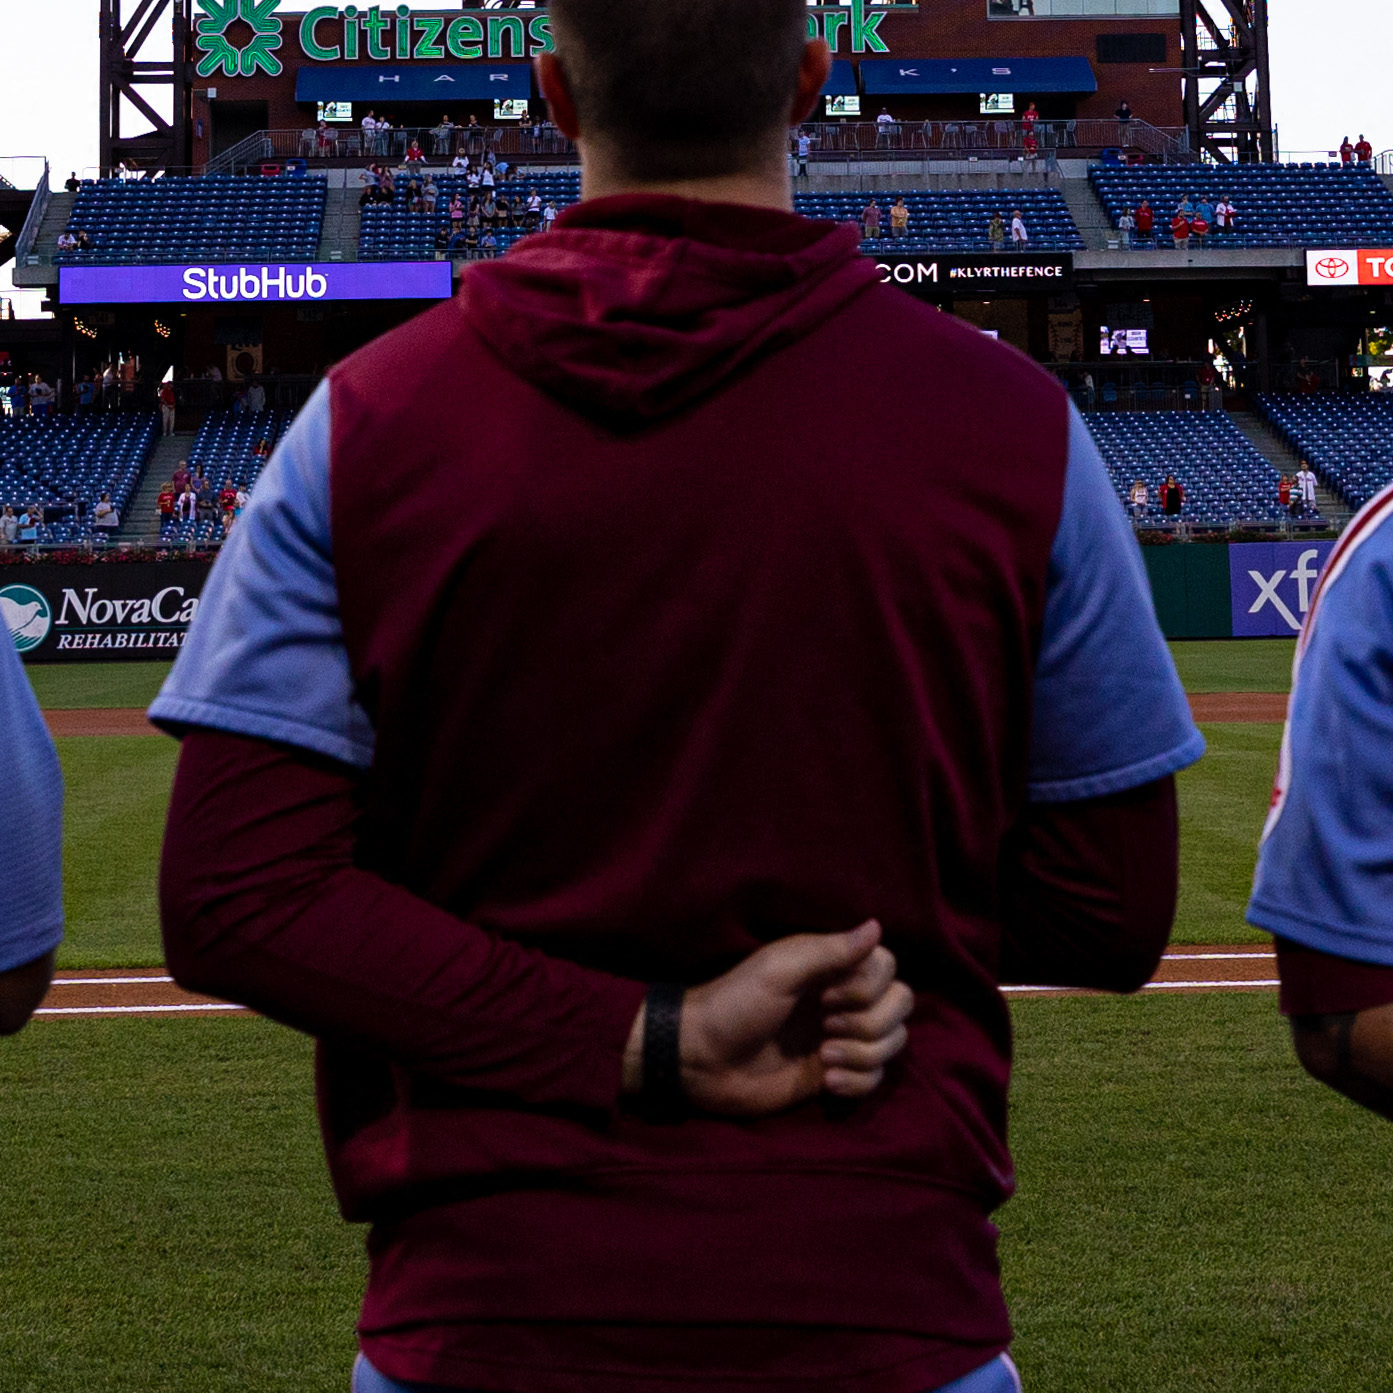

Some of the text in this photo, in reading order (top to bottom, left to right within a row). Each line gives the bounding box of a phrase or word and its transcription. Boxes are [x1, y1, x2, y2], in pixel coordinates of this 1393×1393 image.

[298, 3, 558, 62] Citizens
[181, 266, 328, 300] StubHub
[949, 265, 1064, 279] #KLYRTHEFENCE
[54, 585, 200, 625] NovaCa
[1247, 548, 1319, 631] xf
[56, 631, 188, 650] REHABILITAT
